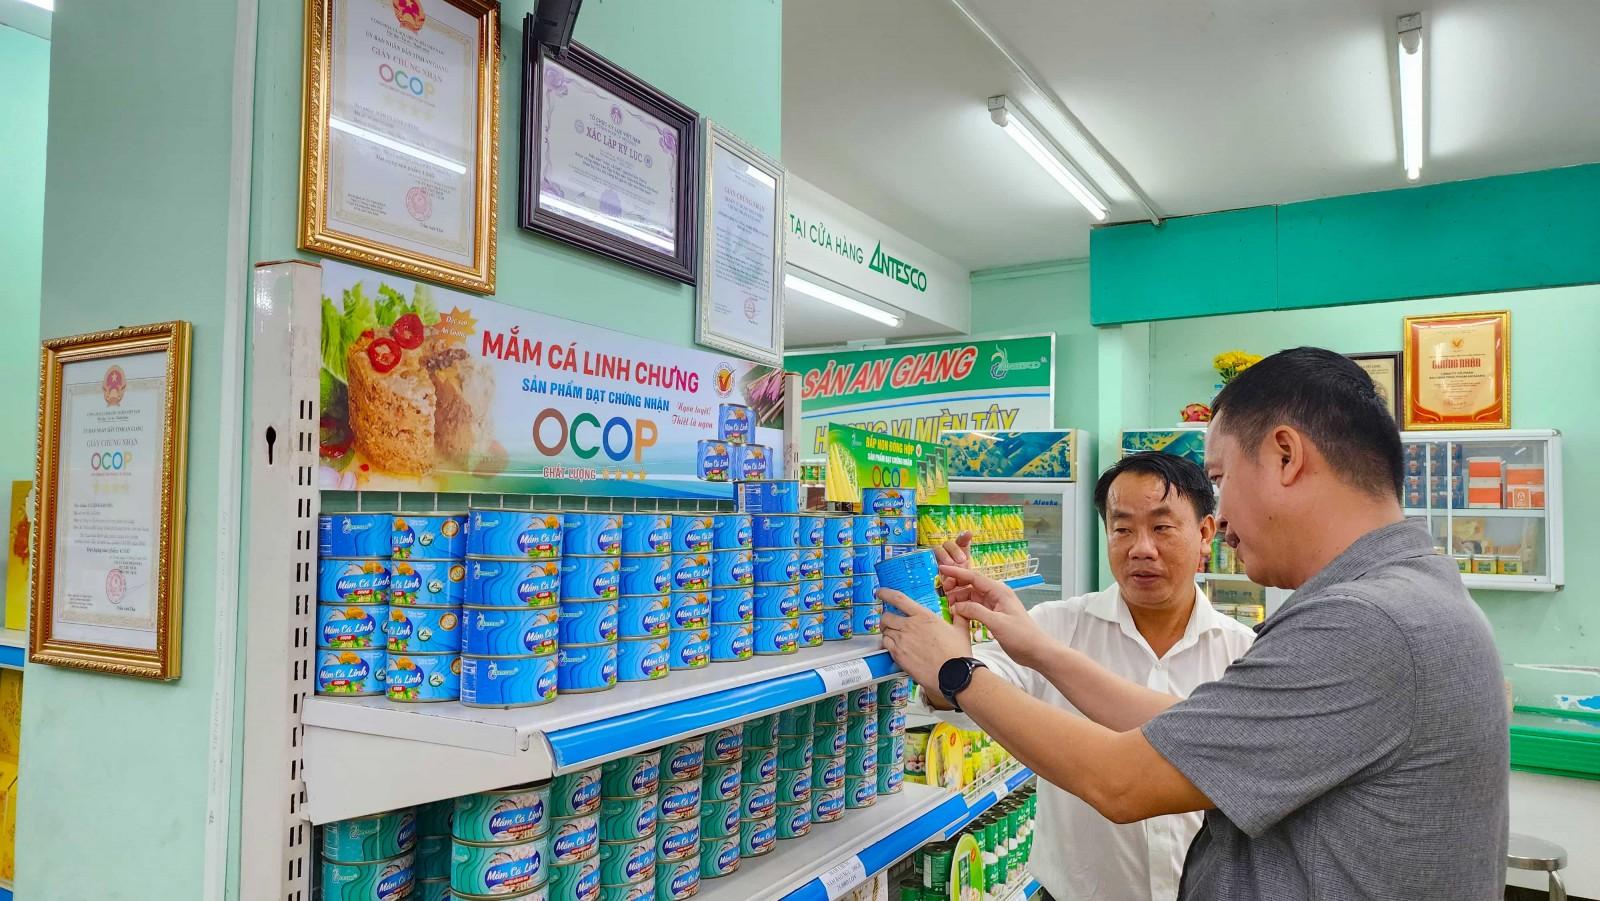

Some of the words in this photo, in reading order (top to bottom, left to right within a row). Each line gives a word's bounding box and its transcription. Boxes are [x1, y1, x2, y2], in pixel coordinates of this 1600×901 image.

[379, 63, 434, 97] OCOP
[789, 214, 806, 239] TẠI
[809, 222, 833, 251] CỬA
[835, 235, 864, 264] HÀNG
[868, 240, 927, 292] ANTESCO
[482, 325, 543, 366] MẮM
[547, 342, 578, 373] CÁ
[583, 351, 631, 382] LINH
[635, 361, 699, 393] CHƯNG
[801, 360, 854, 399] SẢN
[848, 357, 892, 395] AN
[890, 346, 978, 388] GIANG
[522, 375, 547, 394] SẢN
[550, 380, 583, 400] PHẨM
[585, 389, 606, 405] ĐẠT
[608, 390, 641, 408] CHỨNG
[643, 397, 670, 413] NHẬN
[972, 403, 1020, 430] TÂY
[532, 408, 658, 464] OCOP
[91, 452, 133, 470] OCOP
[543, 463, 565, 478] CHẤT
[872, 465, 910, 488] OCOP
